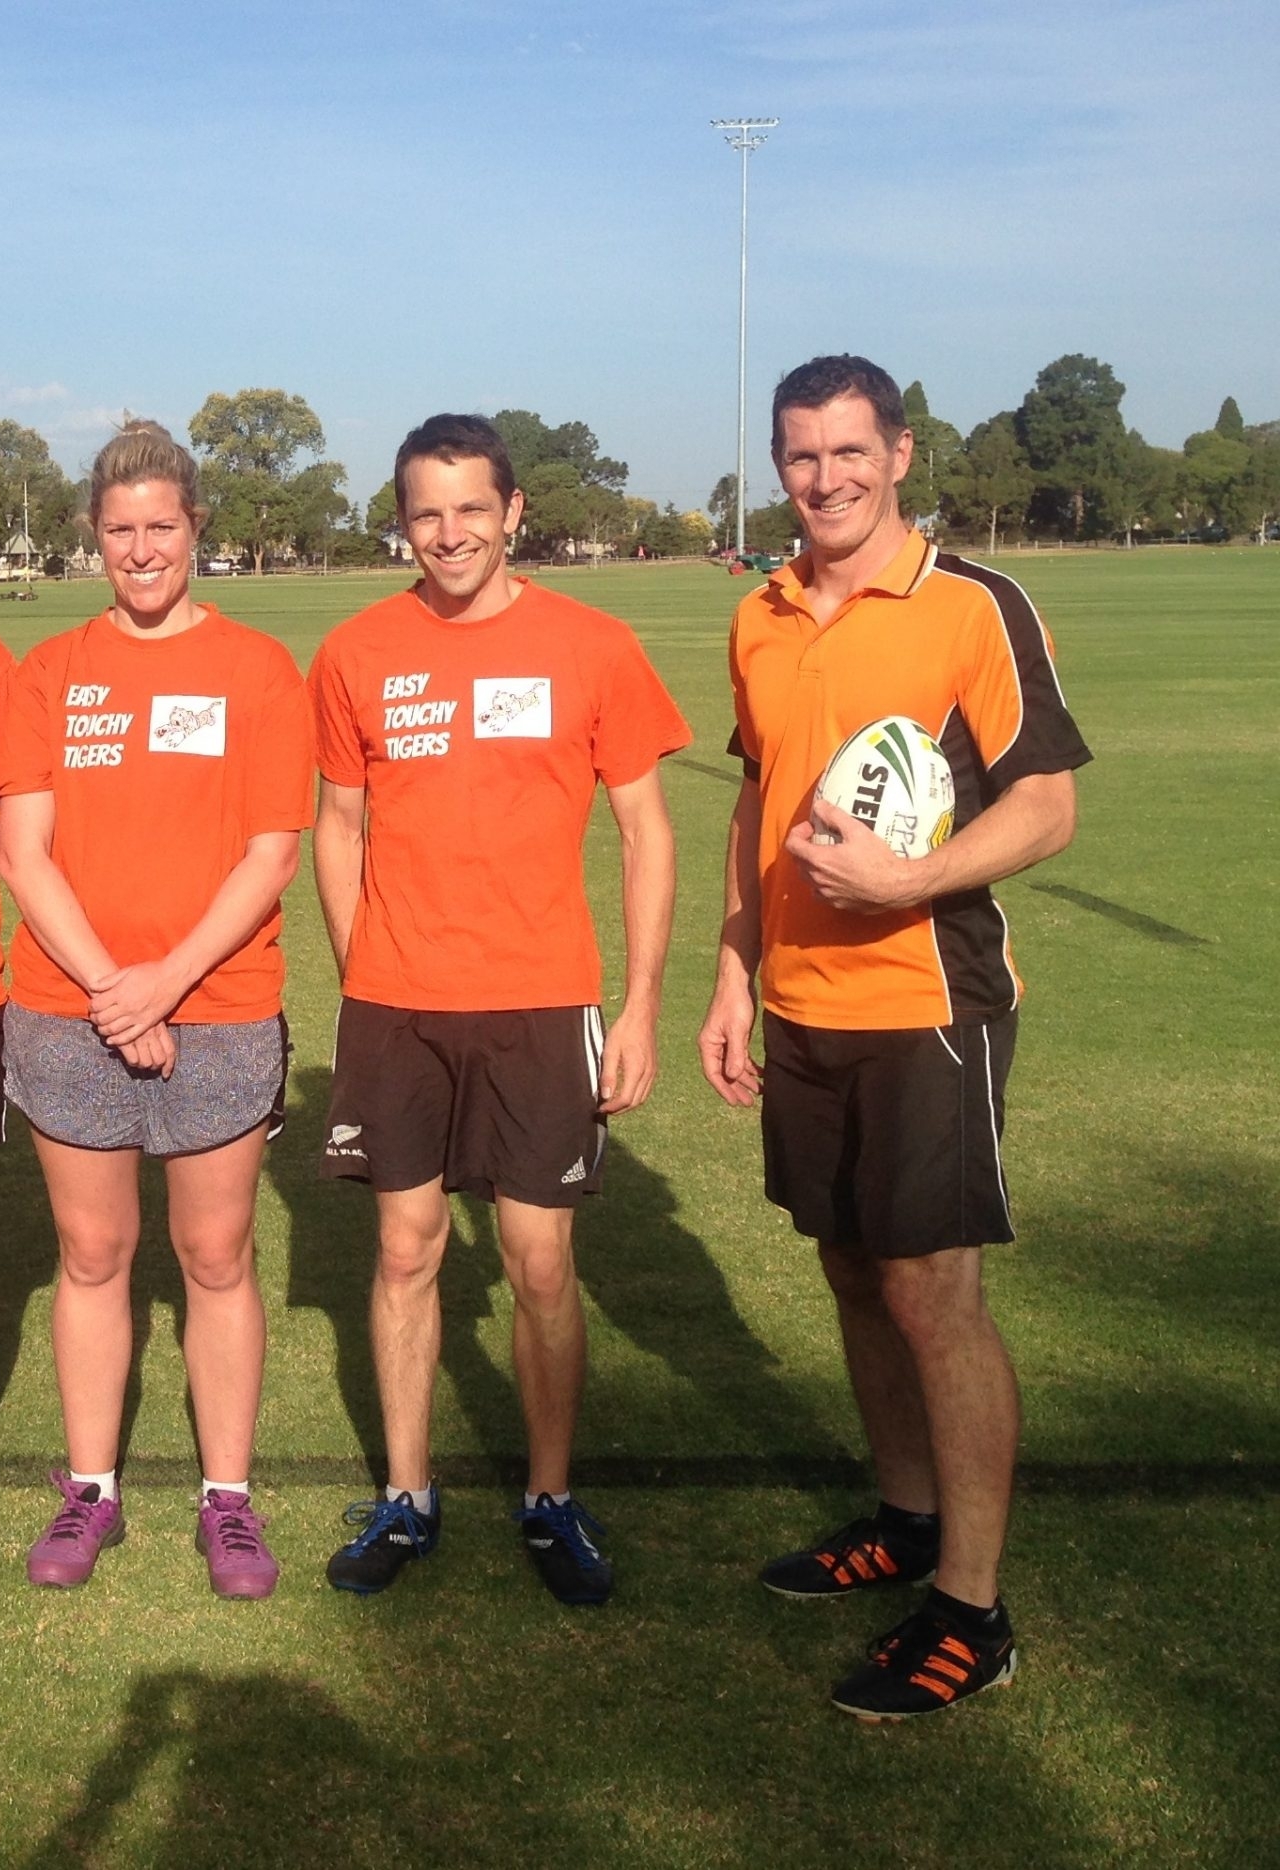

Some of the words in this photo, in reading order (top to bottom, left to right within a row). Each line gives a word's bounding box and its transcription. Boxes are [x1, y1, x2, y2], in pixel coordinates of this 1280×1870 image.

[65, 684, 111, 708] EASY
[382, 672, 431, 700] EASY
[65, 713, 134, 738] TOUCHY
[383, 701, 458, 730] TOUCHY
[63, 743, 124, 768] TIGERS
[384, 732, 451, 760] TIGERS
